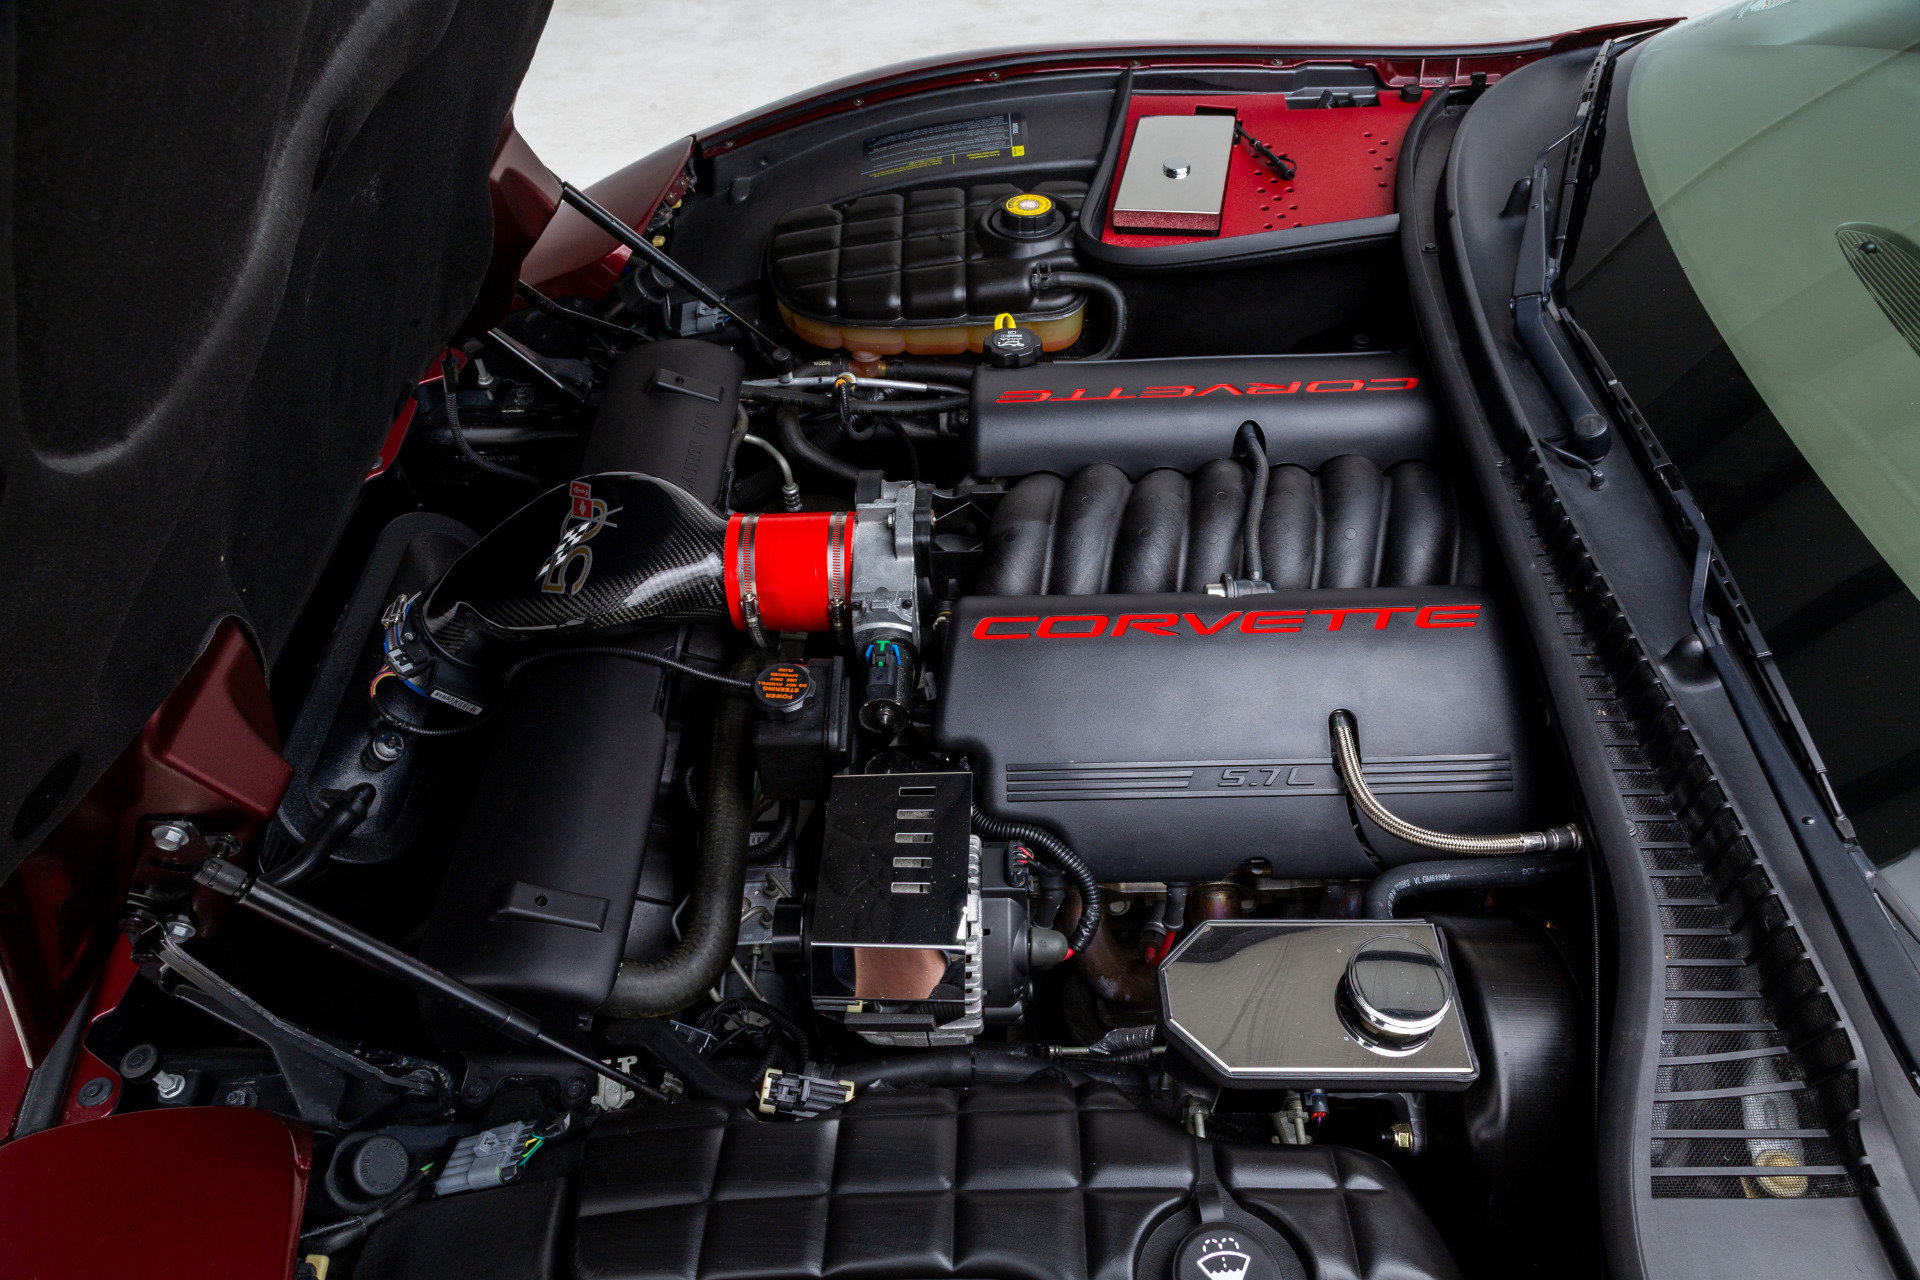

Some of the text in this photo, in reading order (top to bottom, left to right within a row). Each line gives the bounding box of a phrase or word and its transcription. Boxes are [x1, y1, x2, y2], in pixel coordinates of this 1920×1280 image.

[995, 377, 1420, 404] CORVETTE
[972, 604, 1482, 640] CORVETTE
[1217, 766, 1317, 789] 5.7L
